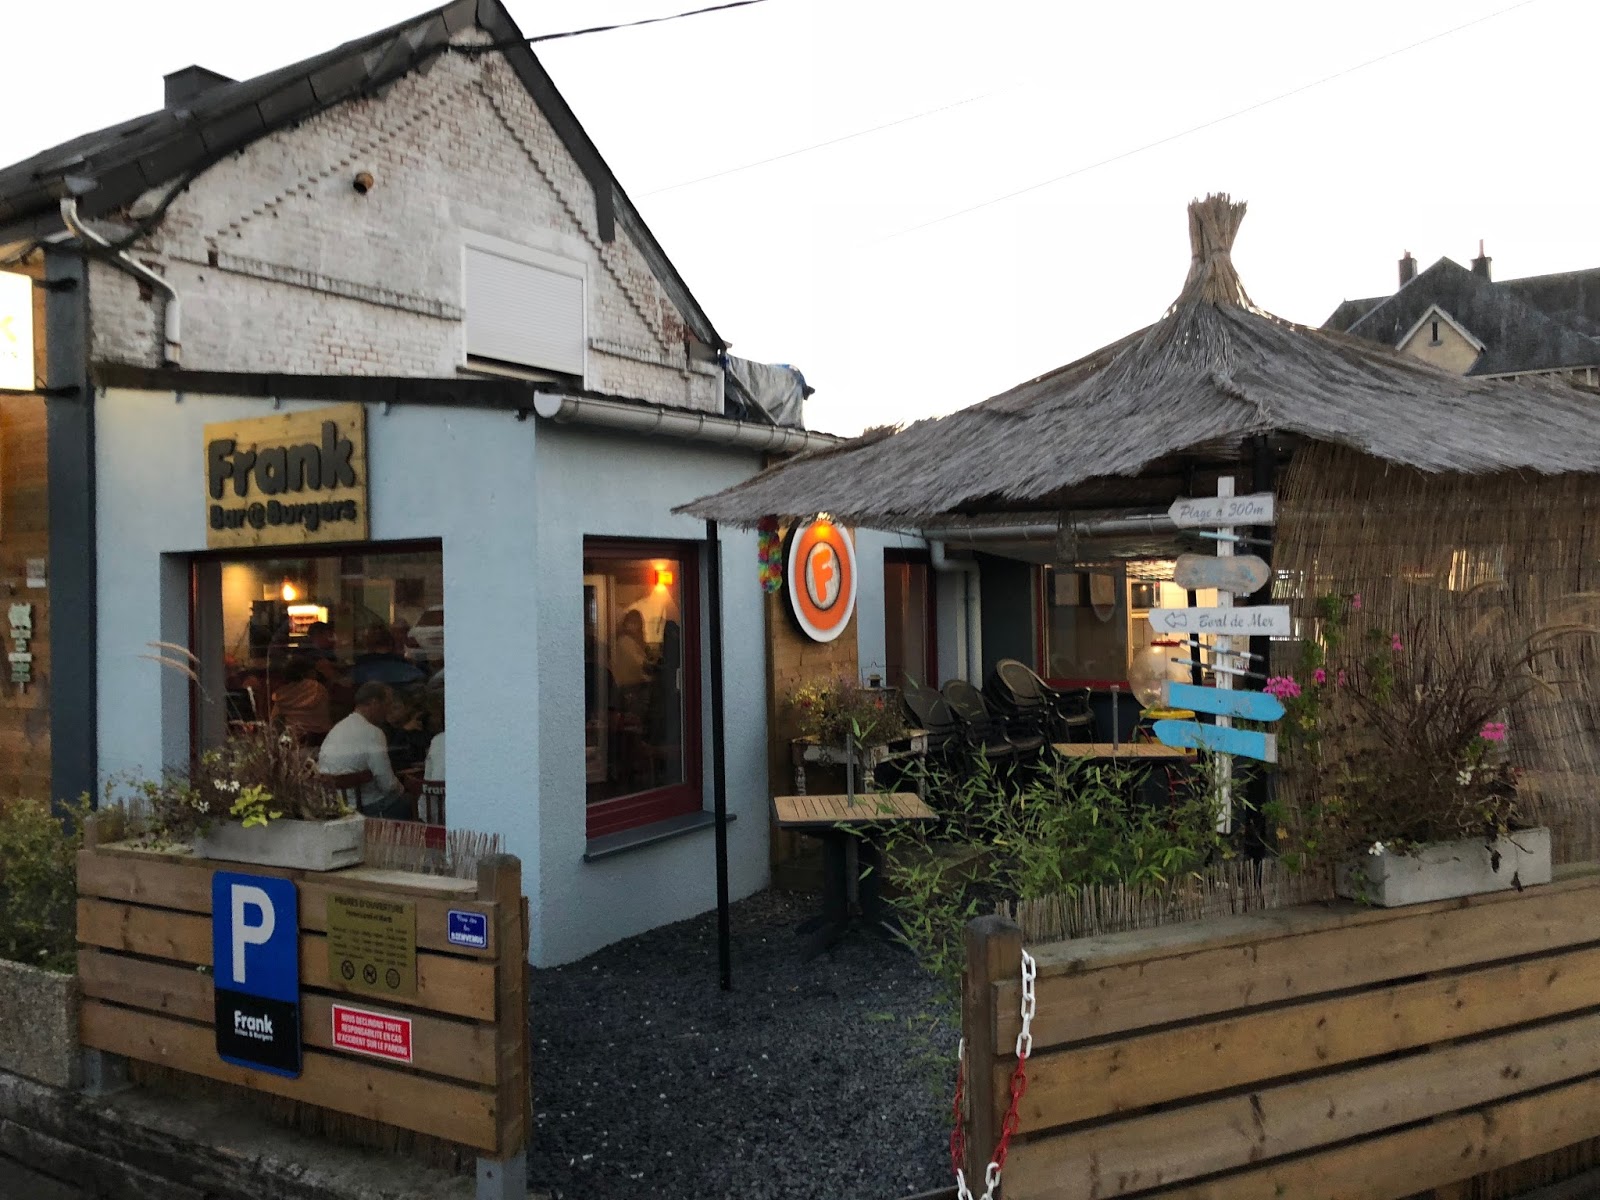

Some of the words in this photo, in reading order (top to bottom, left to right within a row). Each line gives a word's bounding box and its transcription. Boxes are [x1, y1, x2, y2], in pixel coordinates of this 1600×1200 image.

[208, 421, 356, 499] Frank
[210, 504, 247, 530] Bar
[811, 548, 834, 603] F
[1230, 614, 1243, 627] de
[422, 784, 446, 795] Fran
[231, 884, 275, 984] P
[234, 1010, 273, 1034] Frank
